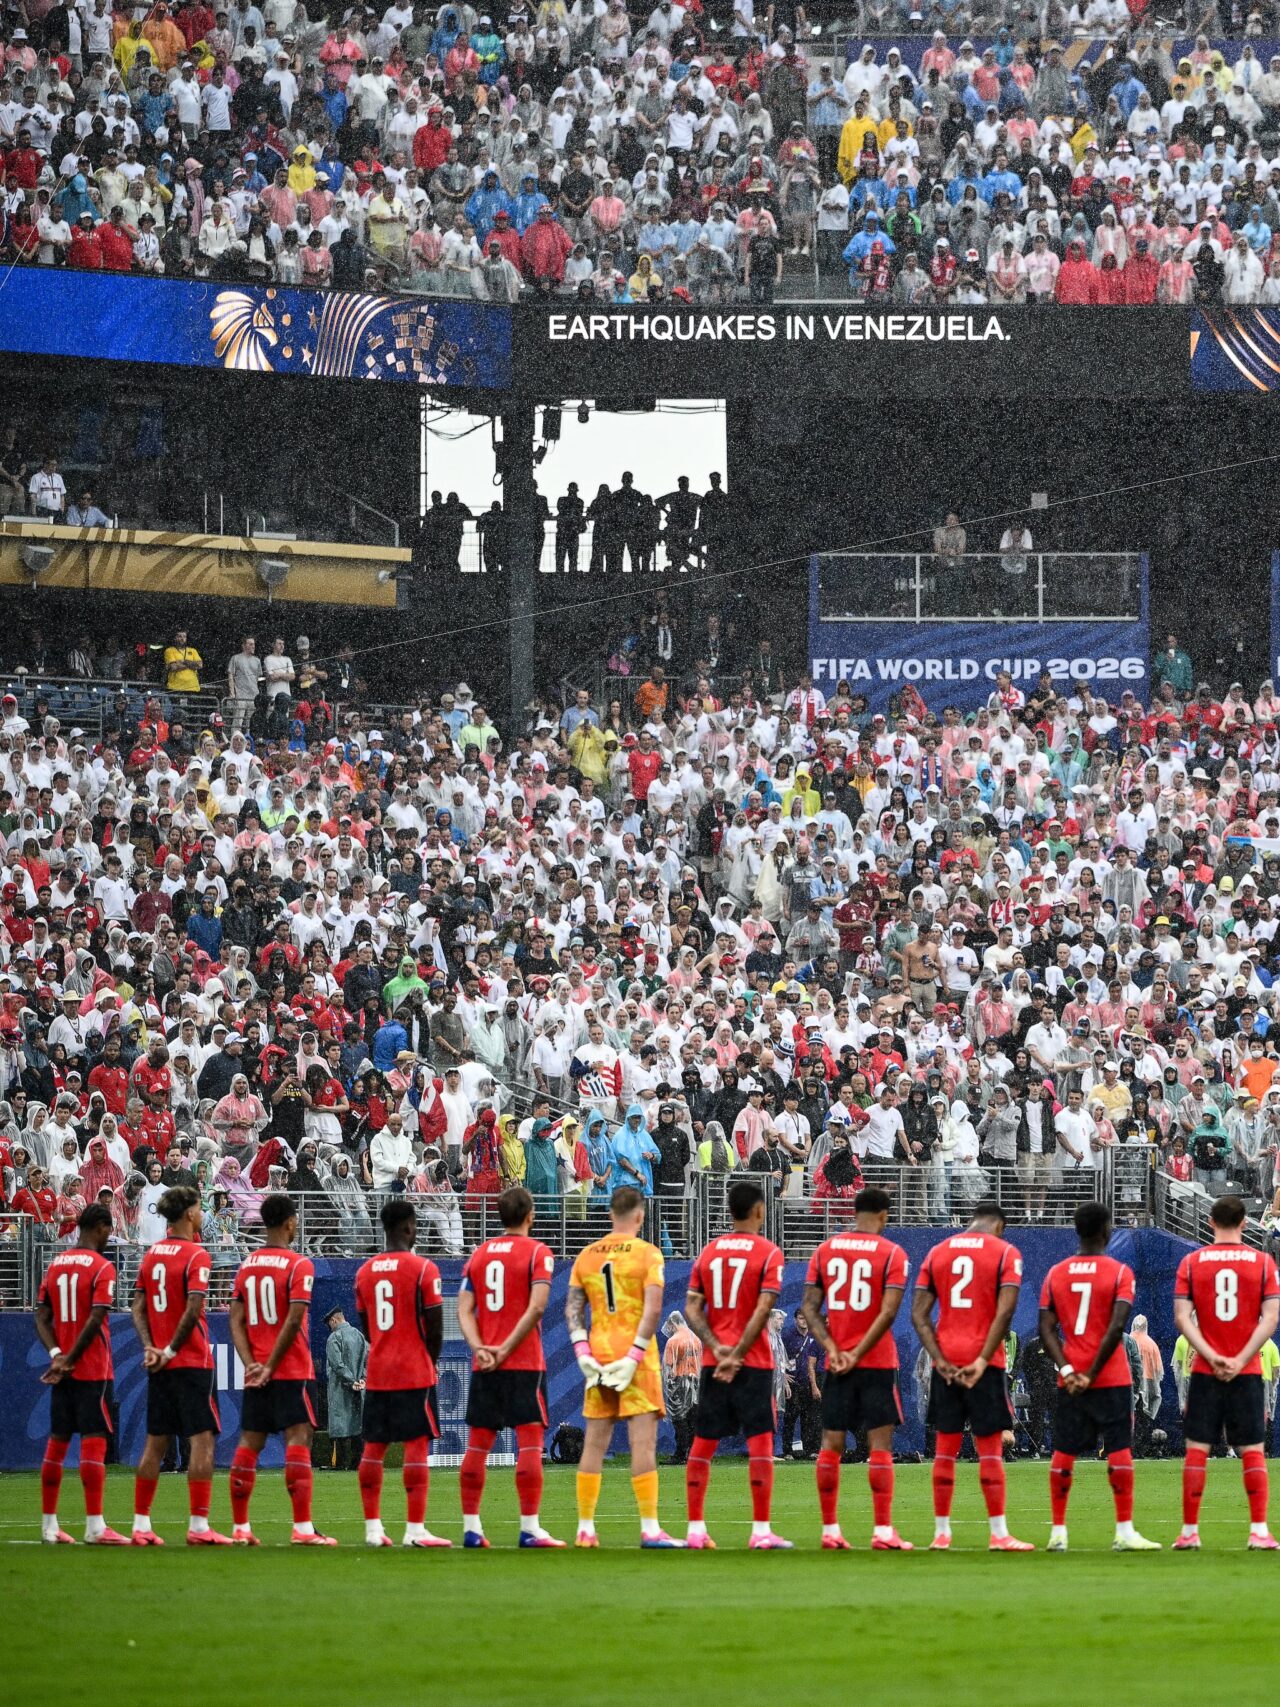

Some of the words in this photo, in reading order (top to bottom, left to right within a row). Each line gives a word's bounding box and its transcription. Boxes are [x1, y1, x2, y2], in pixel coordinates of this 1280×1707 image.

[548, 314, 775, 341] EARTHQUAKES
[786, 315, 815, 340] IN
[822, 315, 1011, 341] VENEZUELA.
[812, 658, 873, 680] FIFA
[876, 658, 980, 680] WORLD
[984, 658, 1042, 680] CUP
[1046, 657, 1146, 680] 2026
[486, 1241, 514, 1253] KANE
[715, 1238, 754, 1251] ROGERS
[829, 1238, 879, 1252] QUANSAH
[949, 1237, 984, 1249] KONSA
[1198, 1250, 1257, 1263] ANDERSON
[152, 1263, 167, 1312] 3
[485, 1260, 505, 1312] 9
[600, 1262, 615, 1313] 1
[709, 1257, 748, 1309] 17
[827, 1257, 872, 1311] 26
[950, 1255, 974, 1309] 2
[1068, 1262, 1097, 1274] SAKA
[56, 1273, 79, 1322] 11
[244, 1275, 278, 1326] 10
[375, 1279, 394, 1331] 6
[1071, 1282, 1092, 1335] 7
[1215, 1268, 1238, 1322] 8
